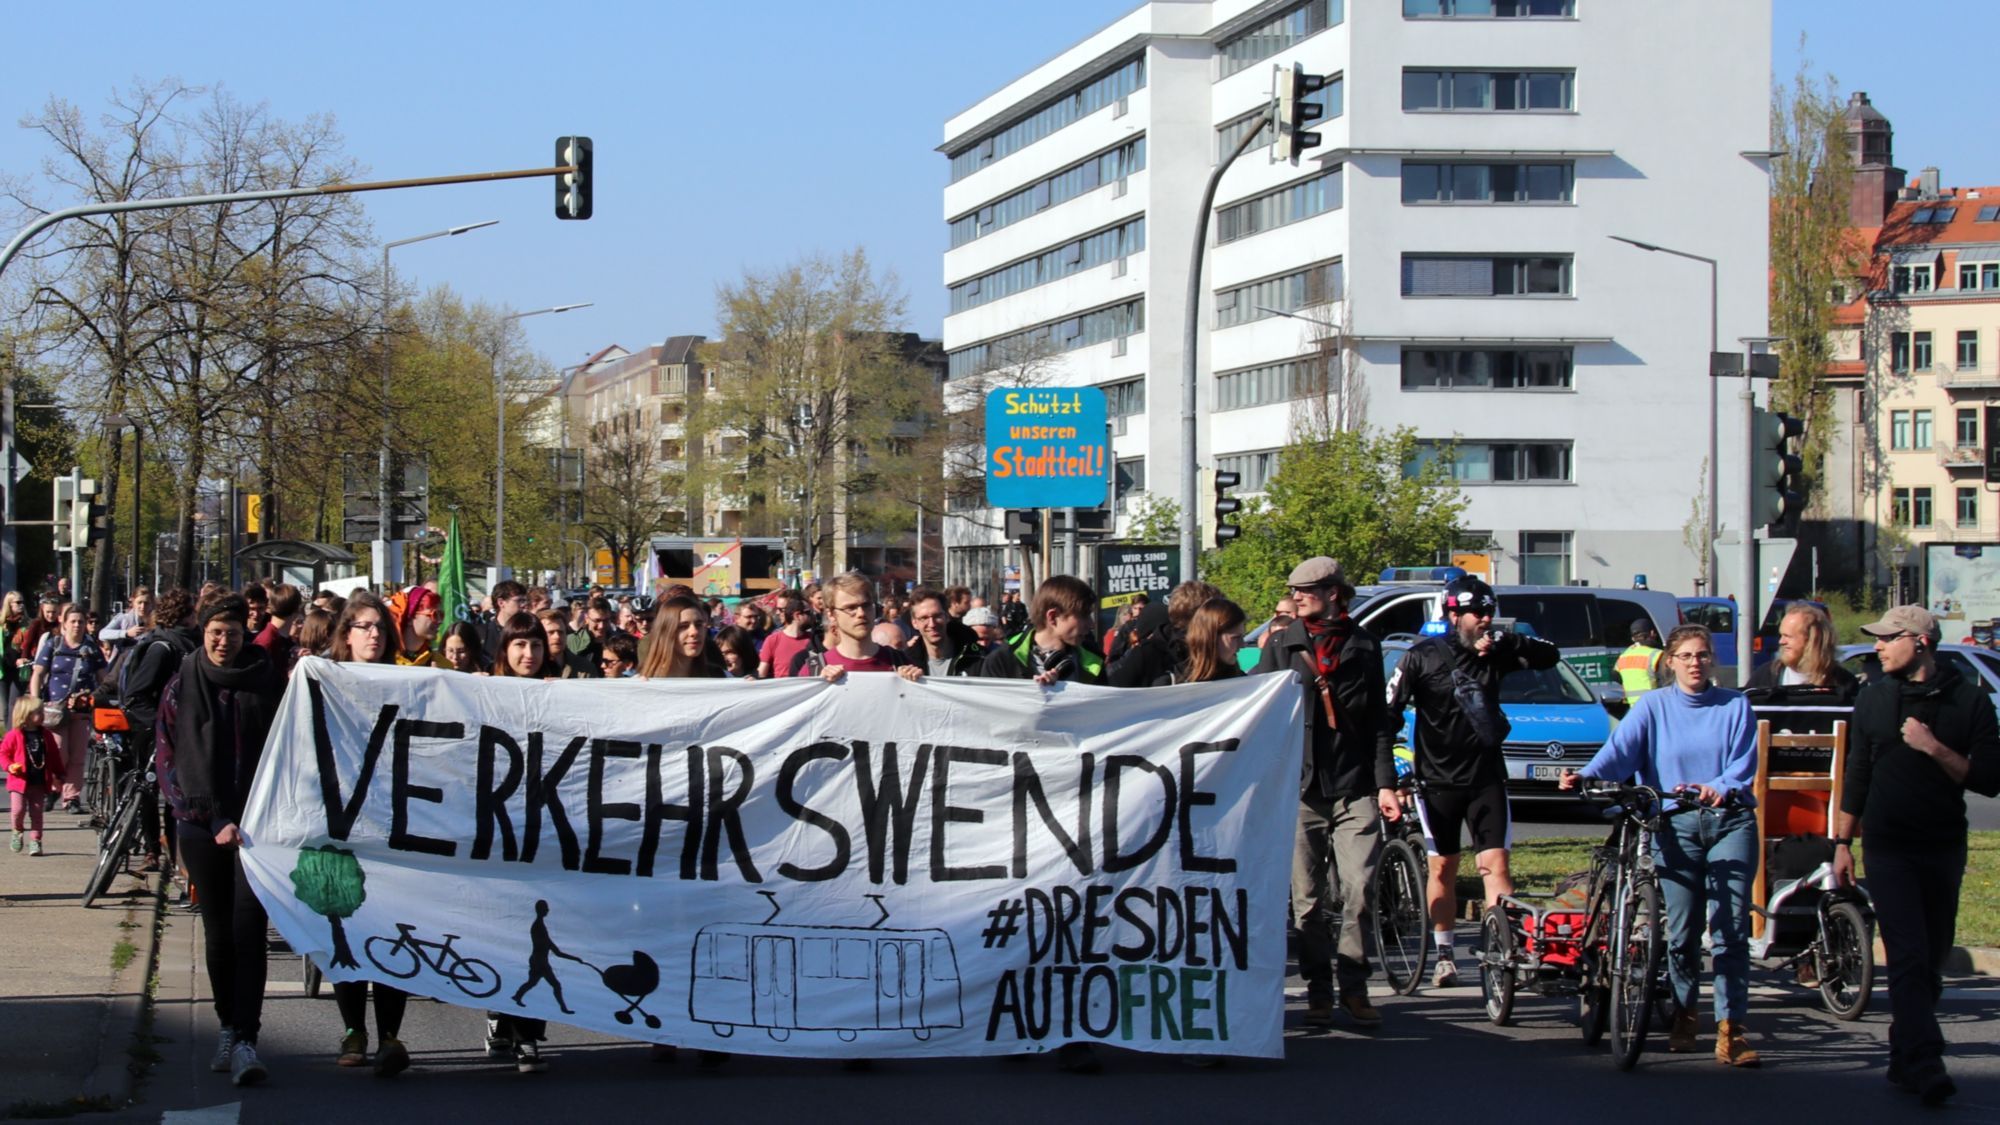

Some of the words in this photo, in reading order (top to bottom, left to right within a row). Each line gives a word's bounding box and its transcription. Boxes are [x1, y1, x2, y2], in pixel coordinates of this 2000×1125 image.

[1005, 392, 1082, 415] Schützt
[1009, 425, 1077, 440] unseren
[993, 445, 1104, 478] Stadtteil!
[1121, 554, 1142, 563] WIR
[1144, 552, 1168, 562] SIND
[1108, 576, 1170, 593] HELFER
[307, 677, 1240, 885] VERKEHRSWENDE
[1535, 766, 1548, 778] DD
[981, 885, 1249, 971] #DRESDEN
[985, 963, 1229, 1042] AUTOFREI
